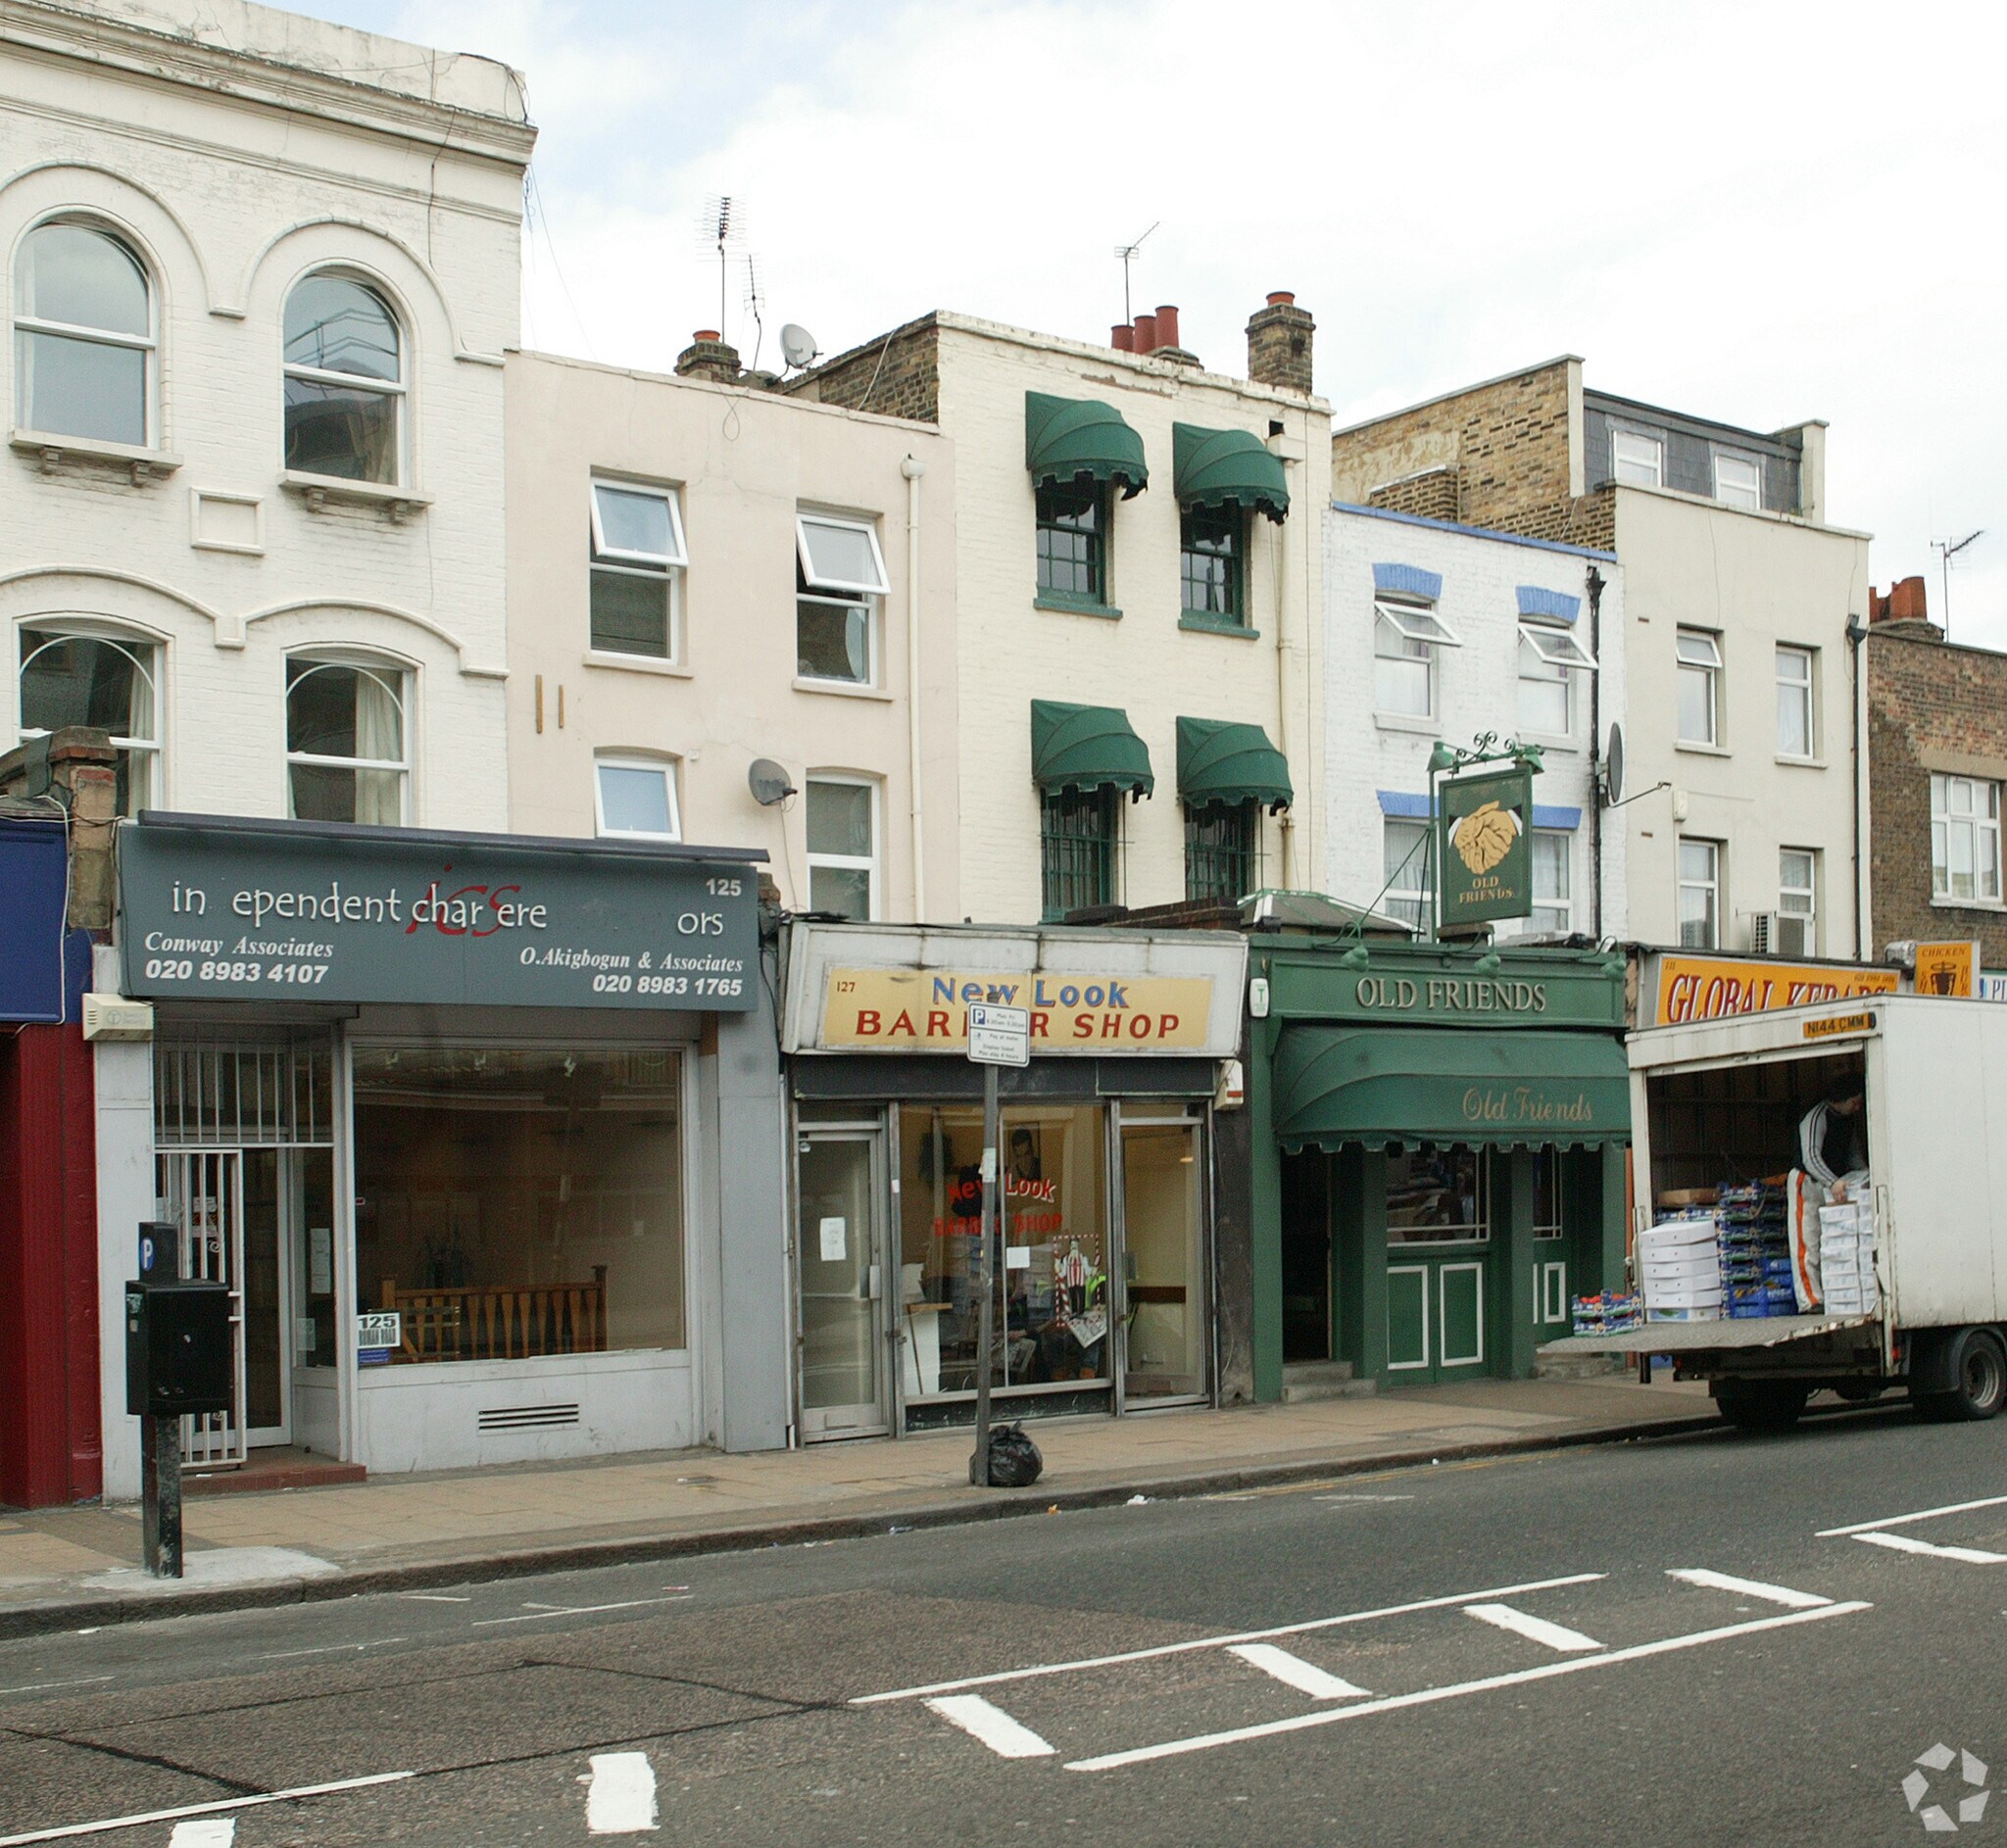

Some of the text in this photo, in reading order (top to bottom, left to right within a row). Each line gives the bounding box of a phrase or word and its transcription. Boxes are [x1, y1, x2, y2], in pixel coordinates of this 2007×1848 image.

[706, 878, 742, 897] 125
[1472, 875, 1499, 889] OLD
[171, 880, 723, 935] in ependent char ere ors
[1459, 887, 1514, 903] FRIENDS
[145, 931, 334, 958] Conway Associates
[1922, 946, 1966, 957] CHICKEN
[145, 959, 328, 984] 020 8983 4107
[519, 947, 743, 972] O.Akigbogun & Associates
[593, 974, 743, 996] 020 8983 1765
[836, 982, 856, 994] 127
[932, 976, 1130, 1008] New Look
[1355, 977, 1546, 1012] OLD FRIENDS
[1667, 974, 1774, 1023] GLOBAL
[855, 1009, 1181, 1039] BARR SHOP
[1808, 1019, 1835, 1035] N144
[1462, 1088, 1592, 1122] Old Friends
[1005, 1173, 1056, 1203] Look
[1013, 1212, 1062, 1234] SHOP
[358, 1315, 396, 1329] 125
